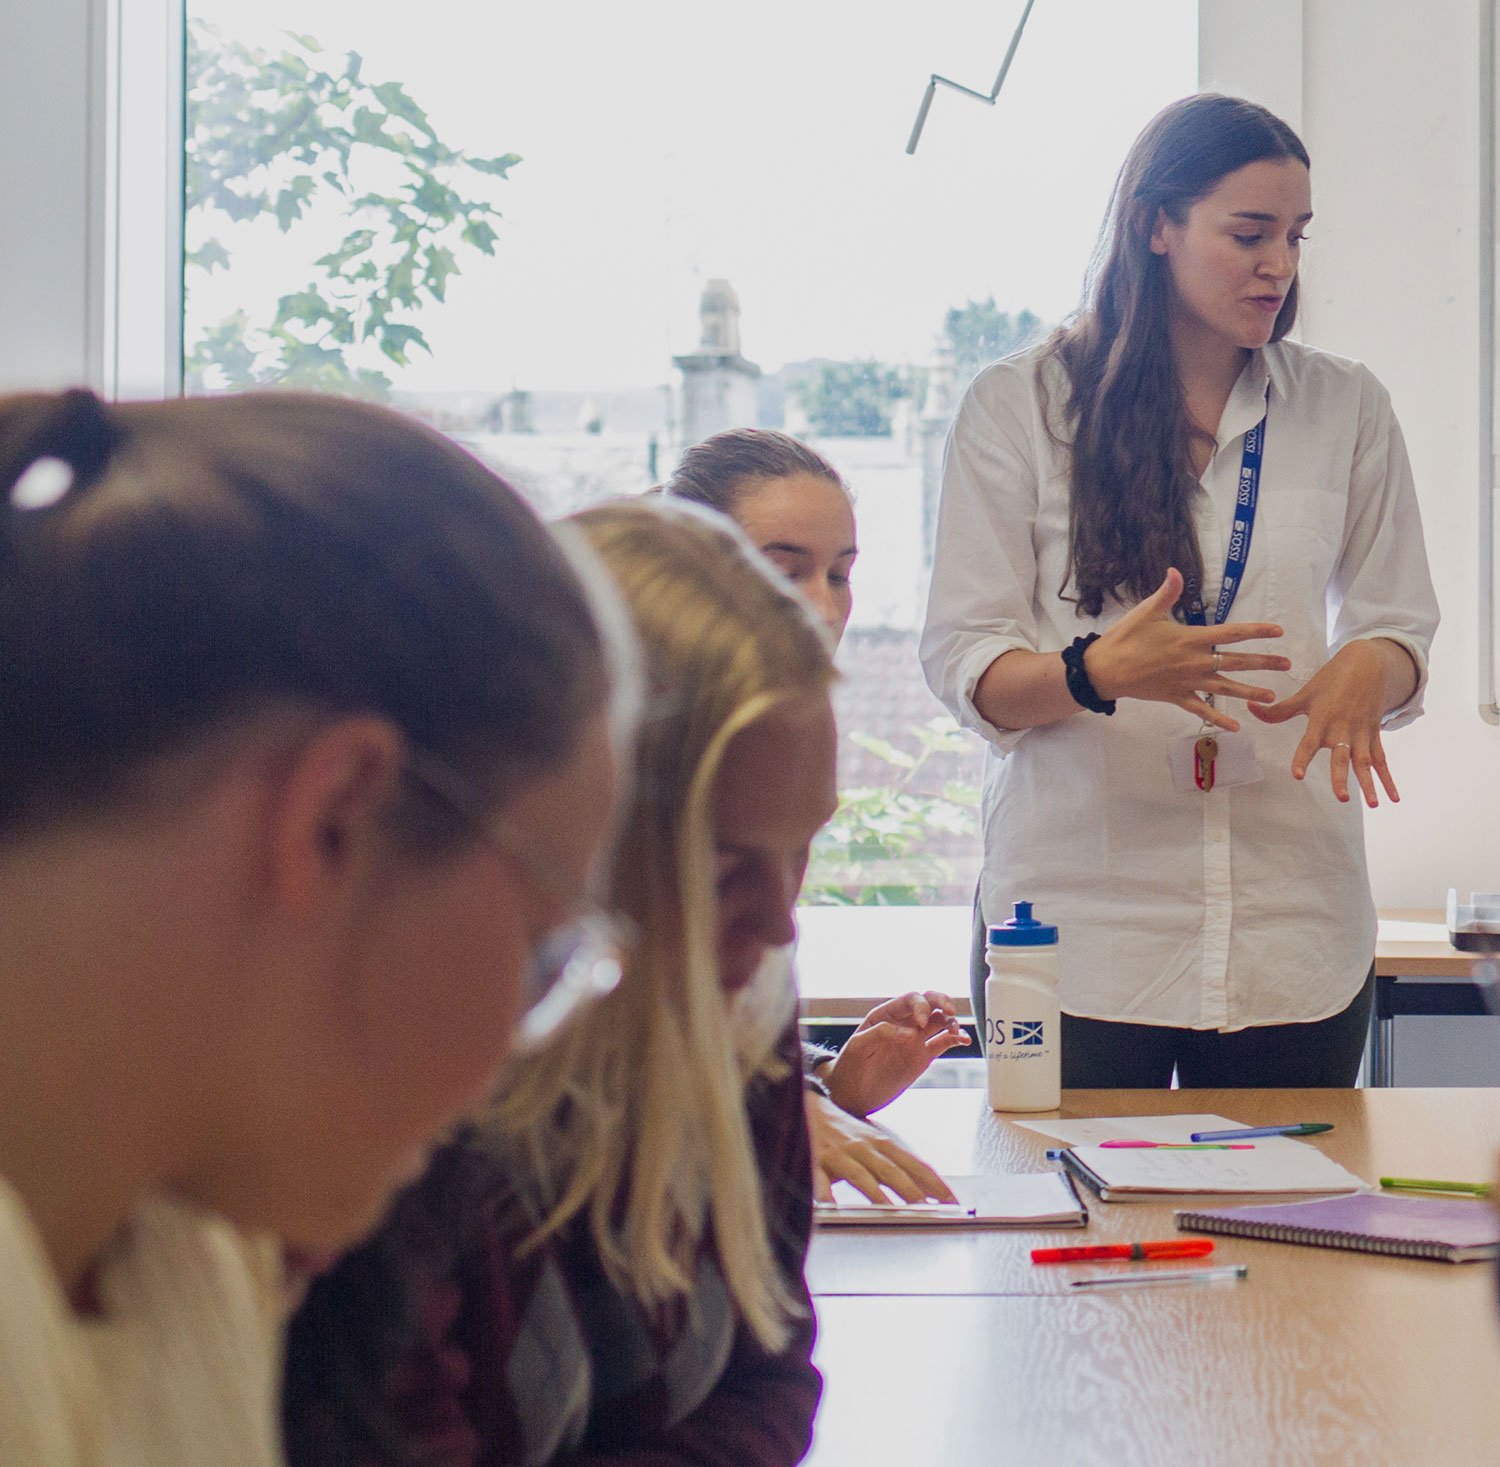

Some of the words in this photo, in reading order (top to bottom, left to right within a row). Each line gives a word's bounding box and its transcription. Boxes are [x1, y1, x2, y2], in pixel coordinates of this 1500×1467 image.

[1245, 427, 1257, 454] ISSO
[1238, 479, 1251, 506] ISSOS
[1229, 531, 1243, 561] ISSOS
